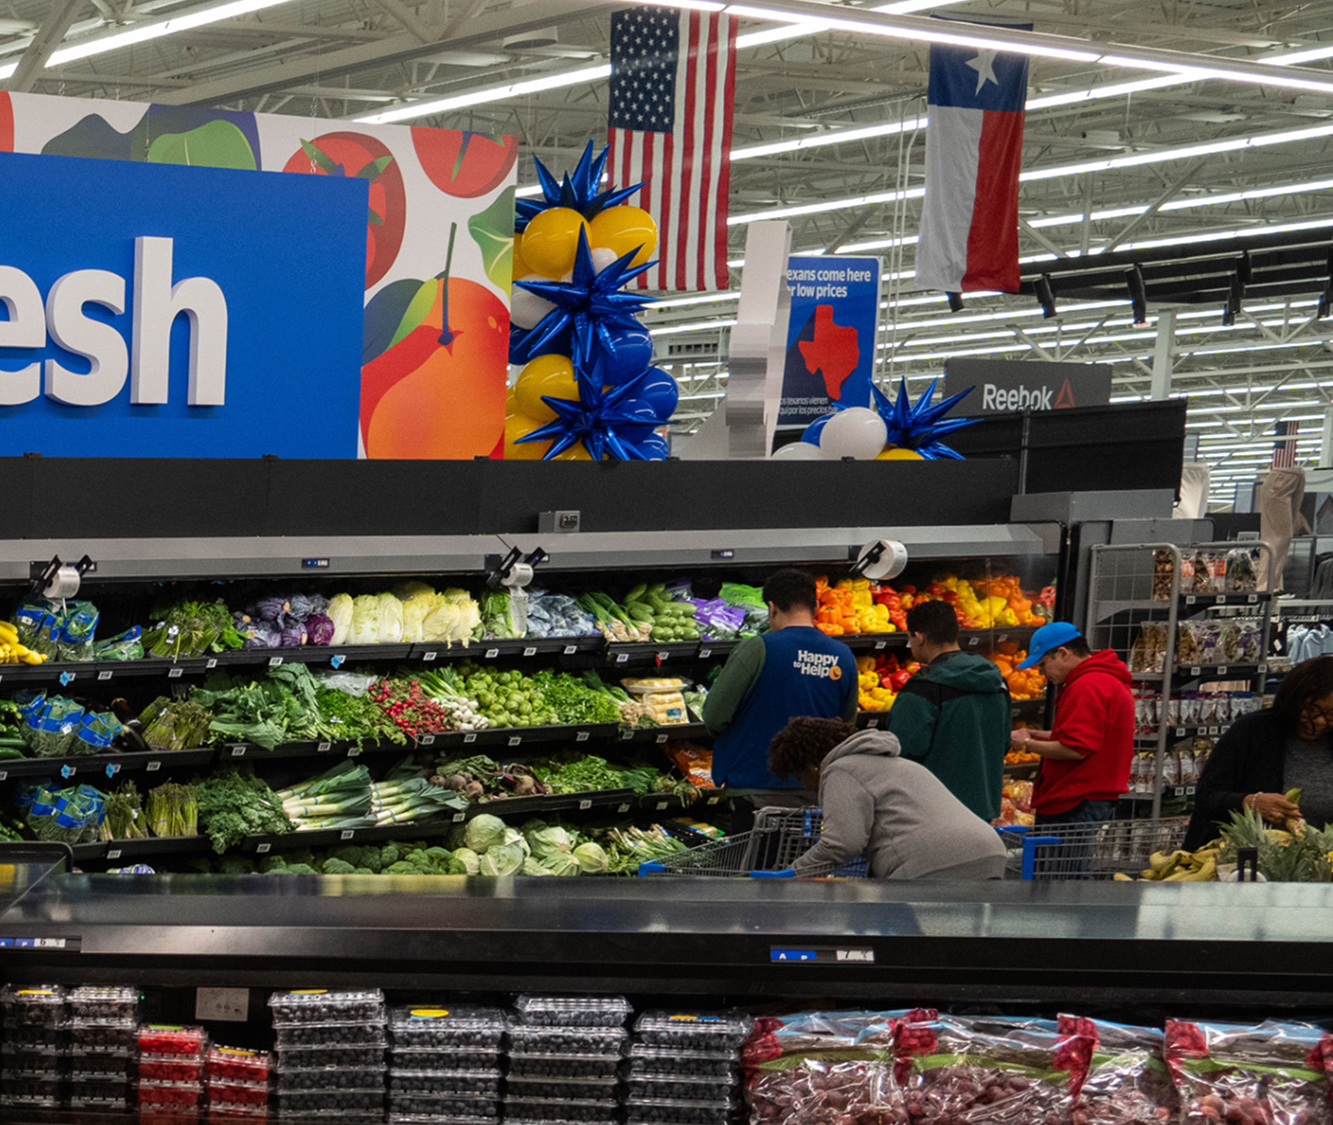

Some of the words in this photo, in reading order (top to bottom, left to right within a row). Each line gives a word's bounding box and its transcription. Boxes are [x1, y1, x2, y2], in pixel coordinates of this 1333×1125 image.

[817, 270, 846, 282] come
[847, 268, 872, 282] here
[797, 284, 815, 298] low
[816, 285, 848, 300] prices
[982, 384, 1054, 411] Reebok
[797, 649, 840, 666] Happy
[800, 662, 830, 678] Help
